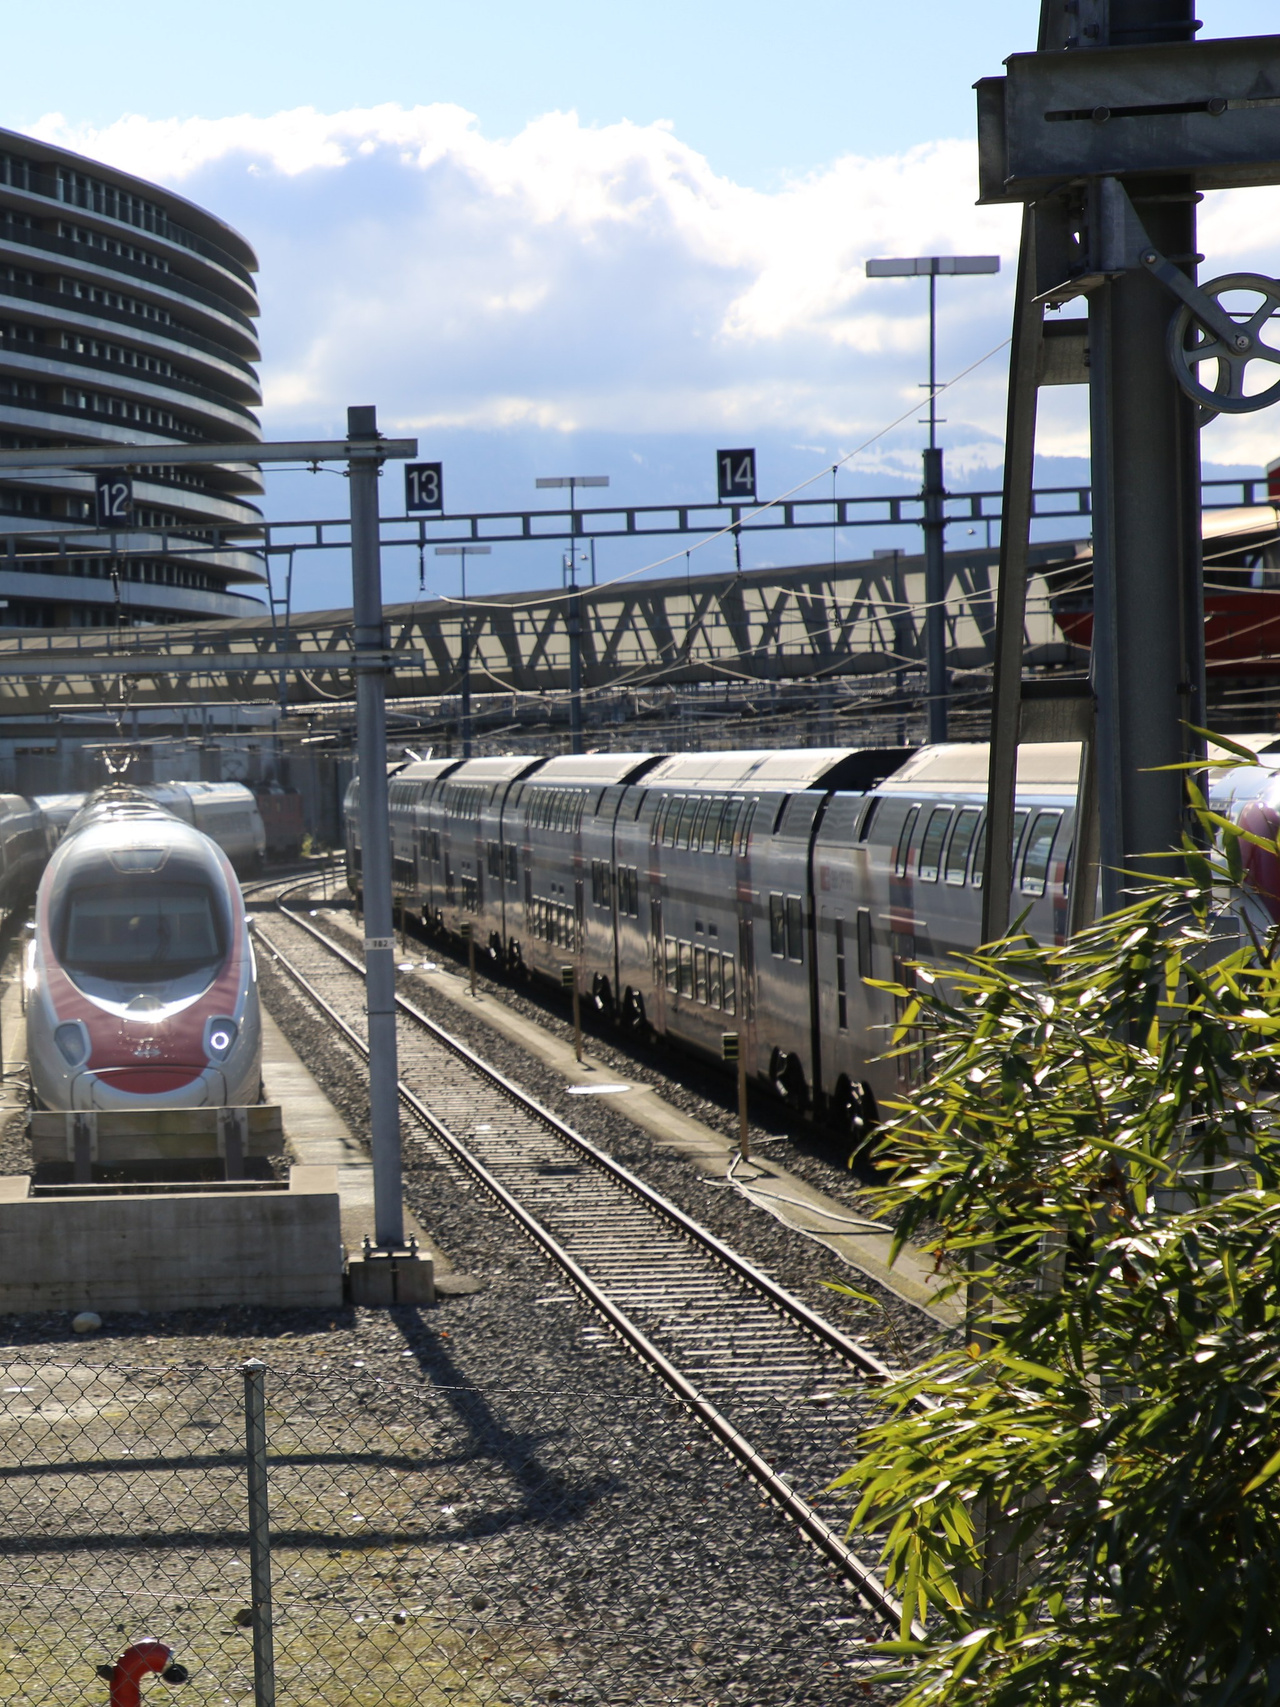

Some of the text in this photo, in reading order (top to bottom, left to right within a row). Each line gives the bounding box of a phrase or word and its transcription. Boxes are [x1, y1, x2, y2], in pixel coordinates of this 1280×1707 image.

[408, 470, 439, 504] 13
[721, 456, 754, 490] 14
[99, 483, 129, 517] 12
